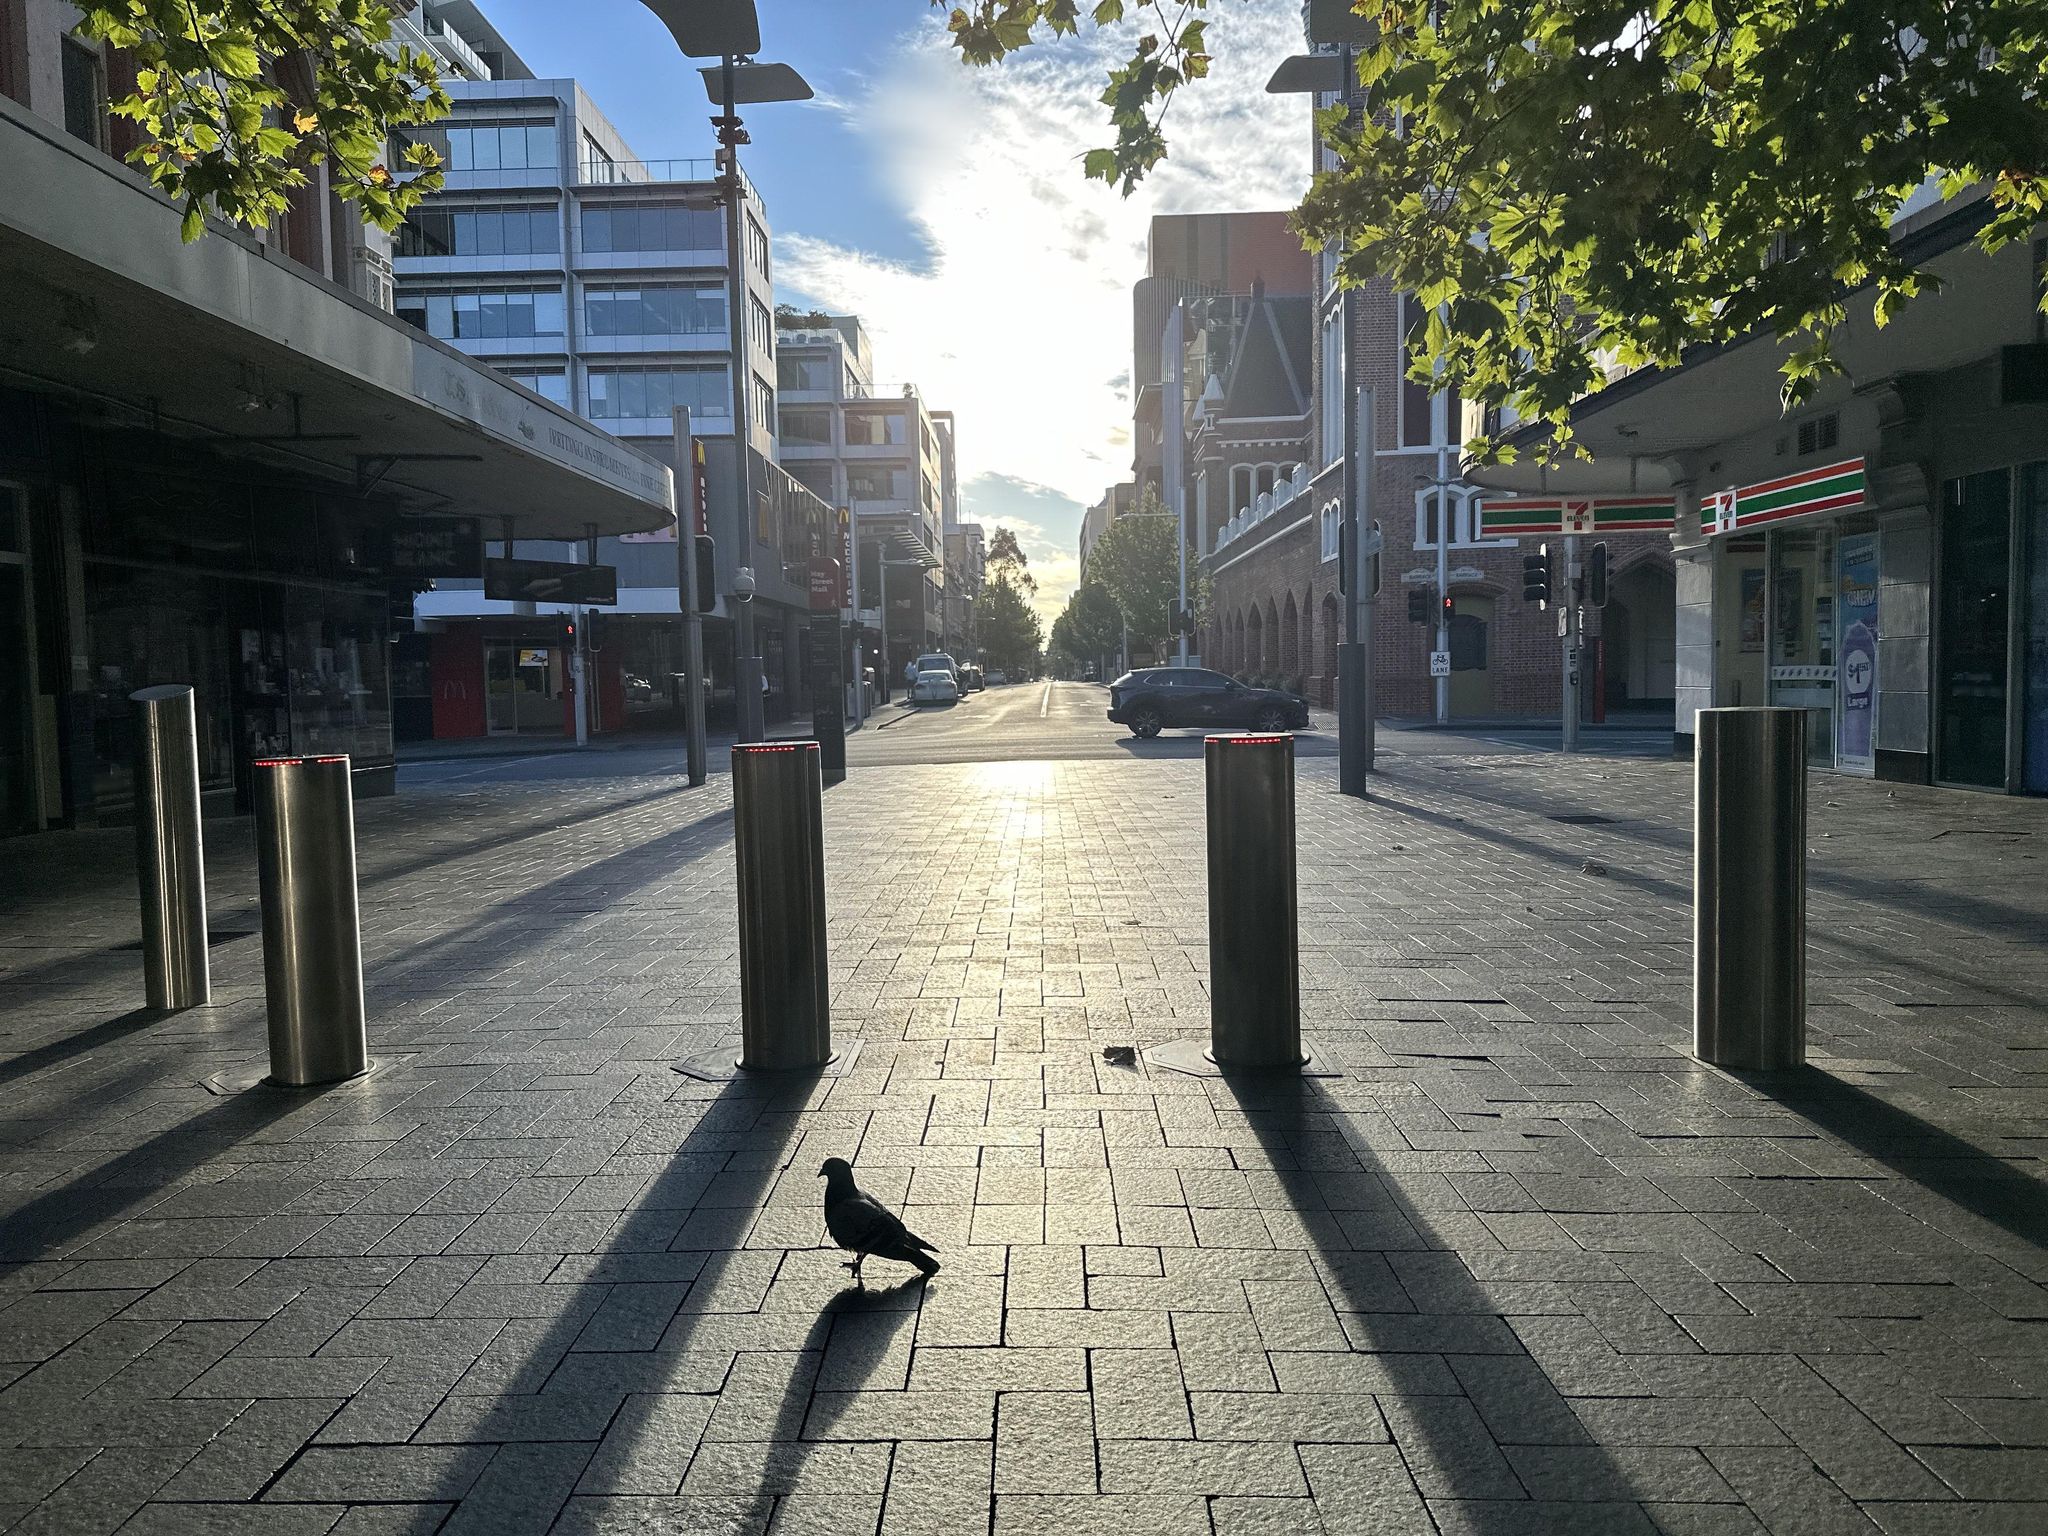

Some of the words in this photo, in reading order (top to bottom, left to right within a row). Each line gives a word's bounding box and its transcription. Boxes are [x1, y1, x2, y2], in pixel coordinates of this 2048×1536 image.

[1567, 501, 1588, 530] 7
[1720, 494, 1733, 531] 7
[1847, 697, 1868, 709] Large
